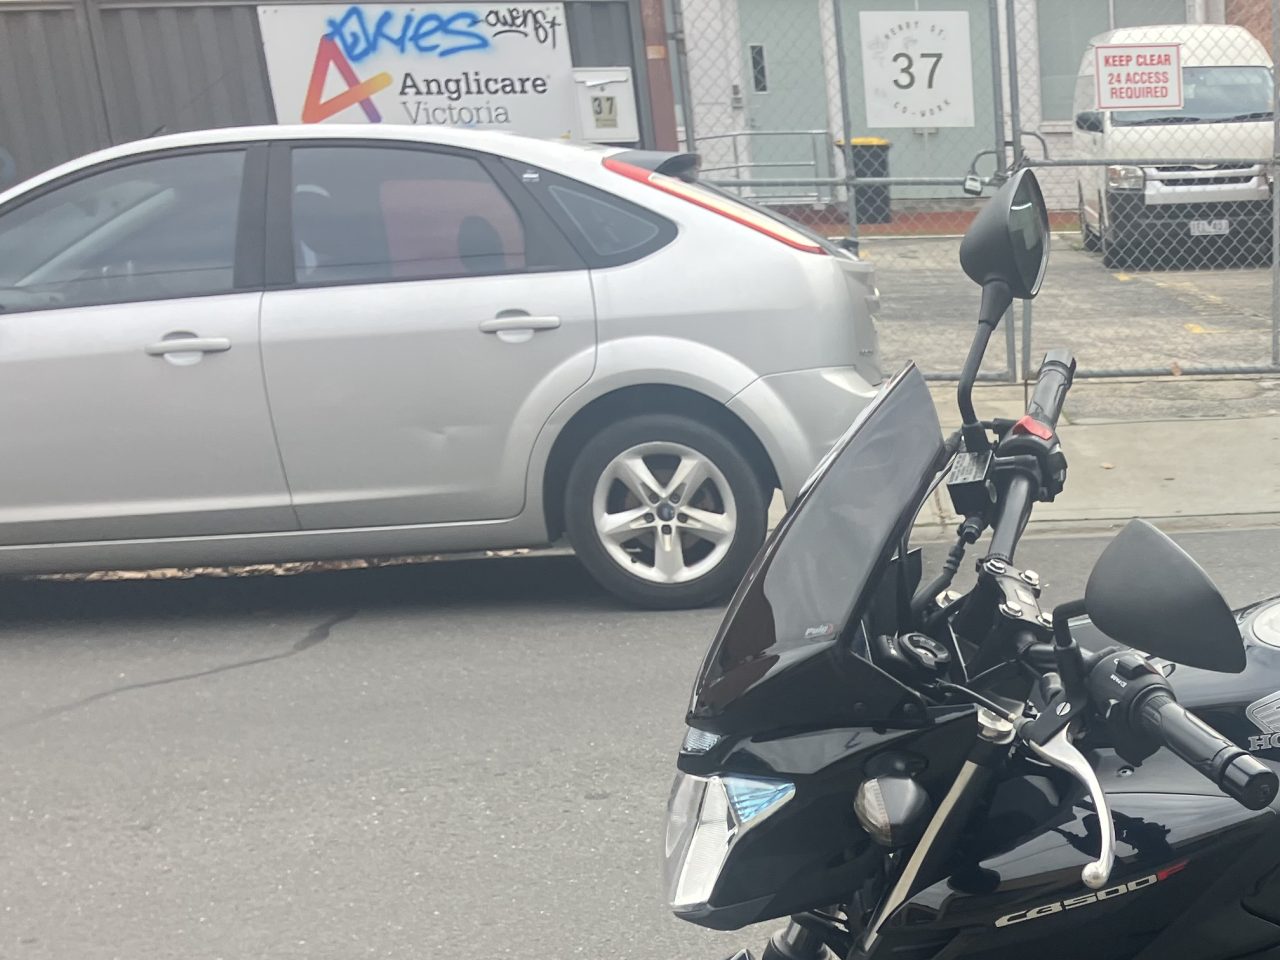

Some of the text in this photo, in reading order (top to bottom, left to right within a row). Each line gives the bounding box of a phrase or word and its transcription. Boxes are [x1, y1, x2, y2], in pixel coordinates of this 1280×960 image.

[1103, 53, 1172, 67] KEEP CLEAR
[892, 52, 943, 90] 37
[1108, 71, 1170, 85] 24 ACCESS
[399, 71, 548, 101] Anglicare
[1110, 86, 1168, 99] REQUIRED
[400, 101, 511, 125] Victoria
[592, 97, 614, 115] 37
